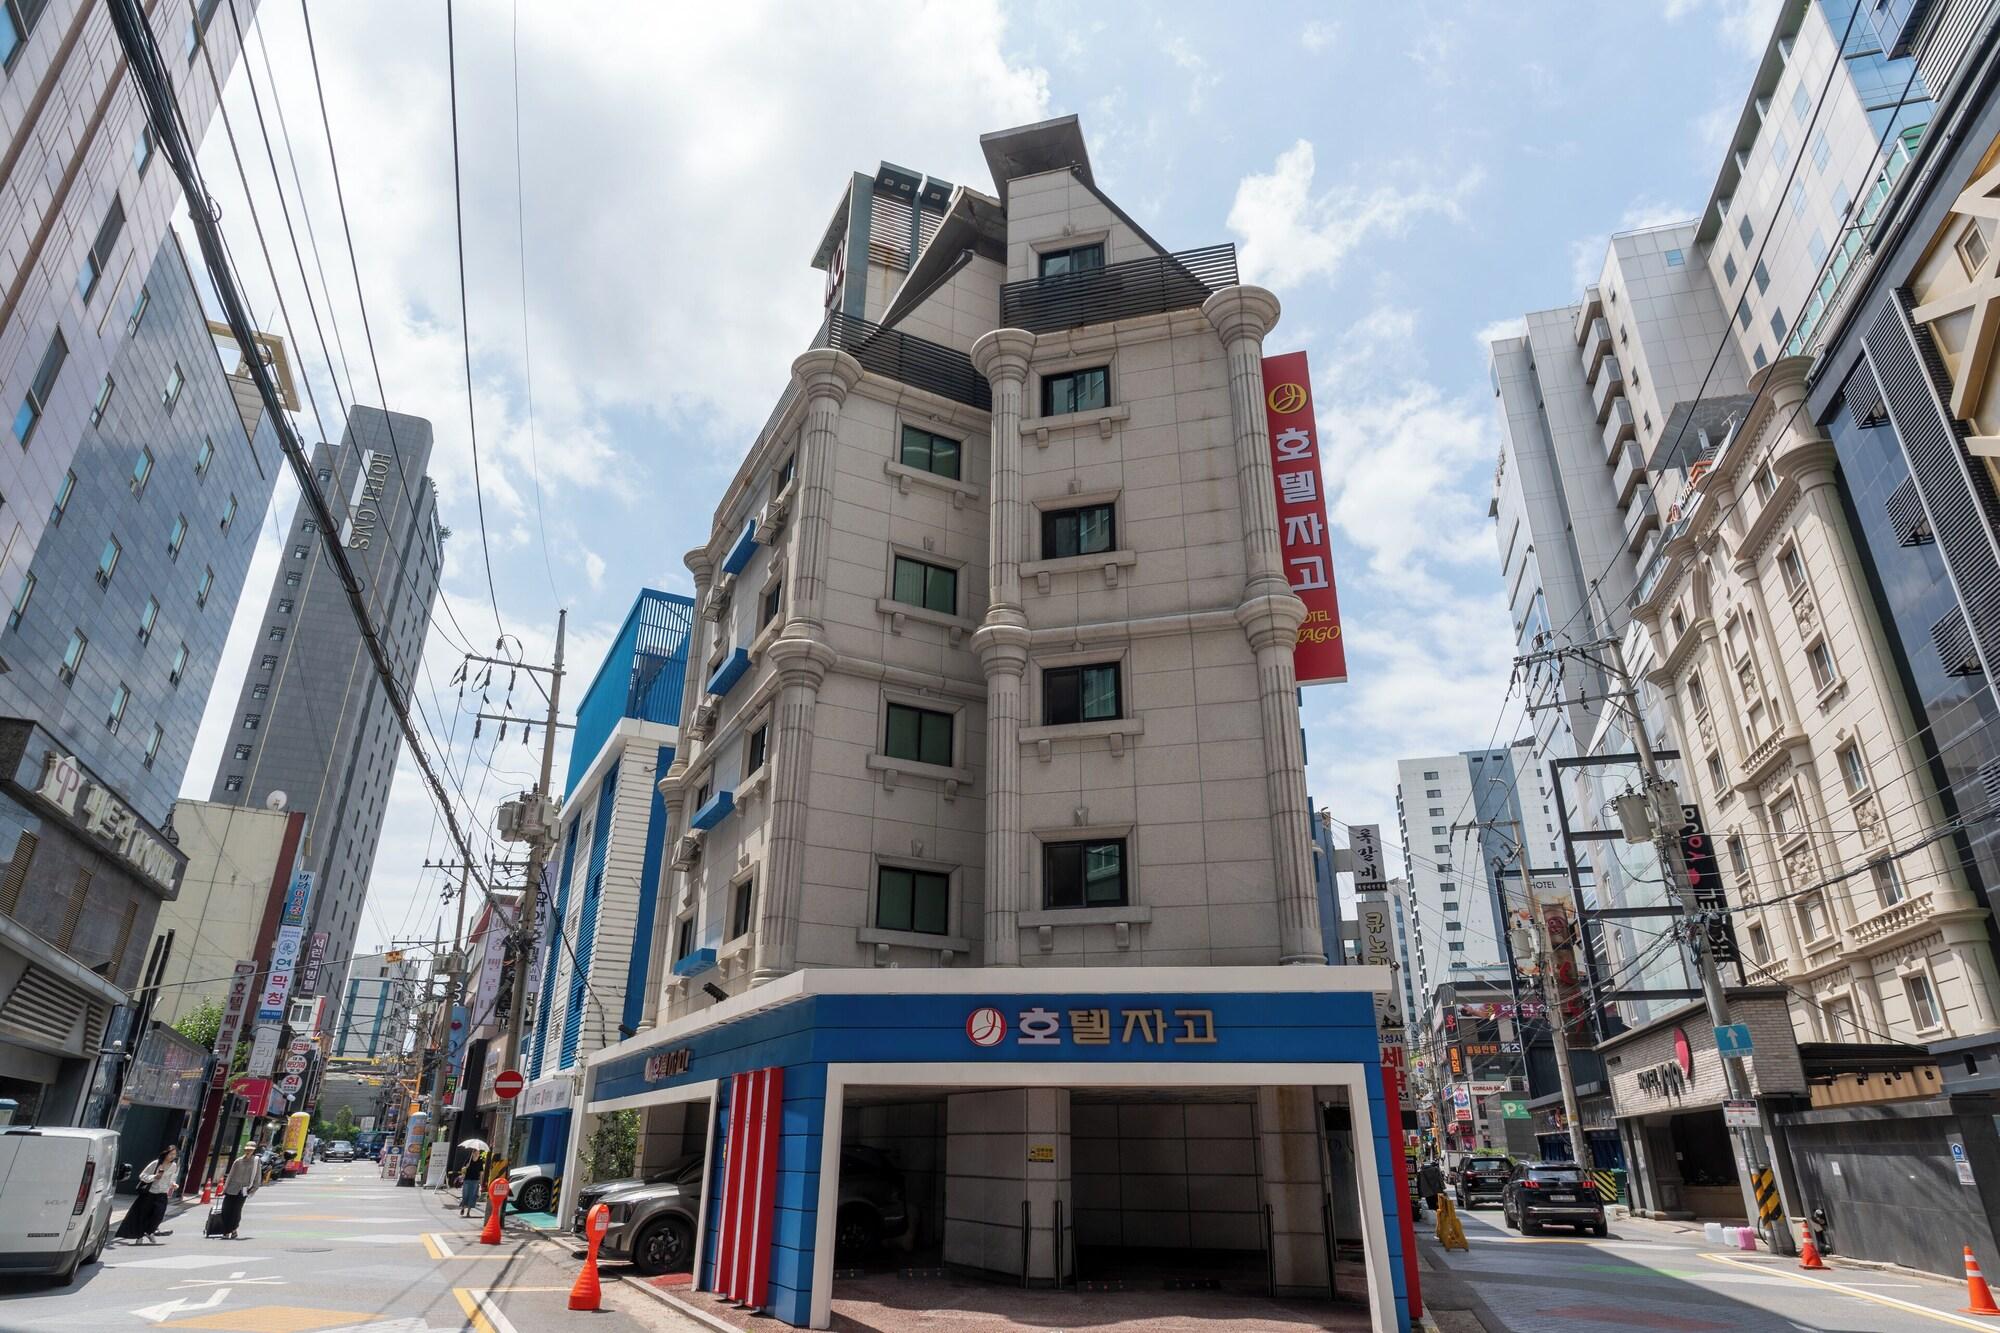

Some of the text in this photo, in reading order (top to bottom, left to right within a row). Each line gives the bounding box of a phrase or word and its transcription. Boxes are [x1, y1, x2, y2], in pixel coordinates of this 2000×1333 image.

[359, 451, 392, 506] HOTEL
[1275, 427, 1330, 594] 호텔자고
[1303, 610, 1332, 624] OTEL
[1017, 1007, 1218, 1045] 호텔자고
